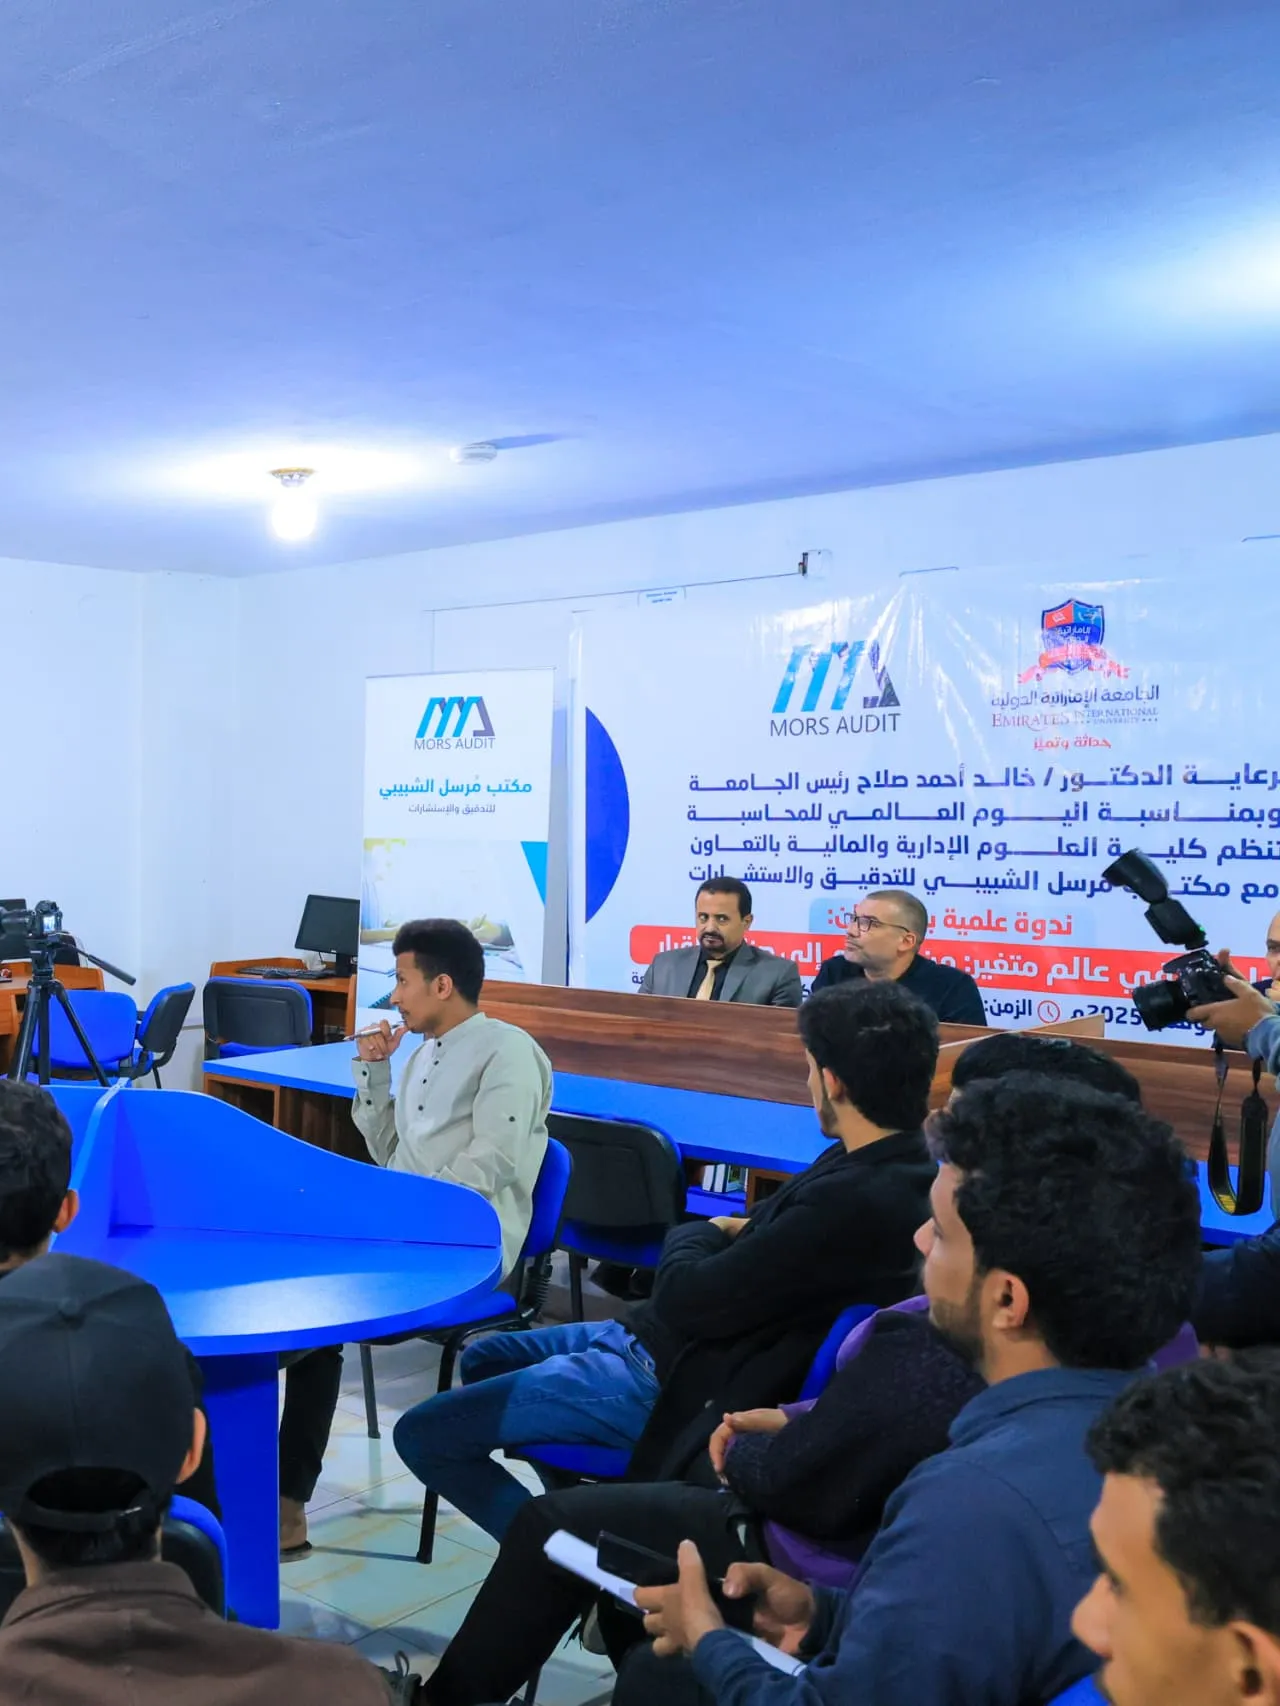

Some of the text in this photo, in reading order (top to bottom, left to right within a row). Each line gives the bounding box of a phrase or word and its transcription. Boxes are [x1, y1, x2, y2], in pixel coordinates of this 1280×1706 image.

[1101, 684, 1159, 704] الجامعة
[770, 713, 901, 737] MORS AUDIT
[414, 737, 496, 751] MORS AUDIT
[1073, 733, 1112, 749] حداثة
[487, 778, 532, 797] مكتب
[689, 772, 799, 795] الجامعة
[806, 771, 850, 794] رئيس
[857, 769, 908, 794] صلاح
[916, 763, 966, 788] أحمد
[973, 766, 1036, 788] خالد
[1059, 764, 1172, 793] الدكتور
[1182, 763, 1280, 791] رعاية
[379, 777, 434, 800] الشبيبي
[462, 803, 496, 815] للتدقيق
[687, 803, 822, 825] للمحاسبة
[828, 801, 965, 829] العالمي
[972, 801, 1088, 828] اليوم
[690, 834, 1280, 866] نظم كلية العلوم الإدارية والمالية بالتعاون
[820, 866, 916, 890] للتدقيق
[923, 868, 1039, 896] الشبيبي
[1047, 871, 1113, 898] مرسل
[1241, 883, 1279, 904] مع
[943, 908, 1007, 937] علمية
[1014, 914, 1073, 940] ندوة
[1046, 956, 1110, 986] عالم
